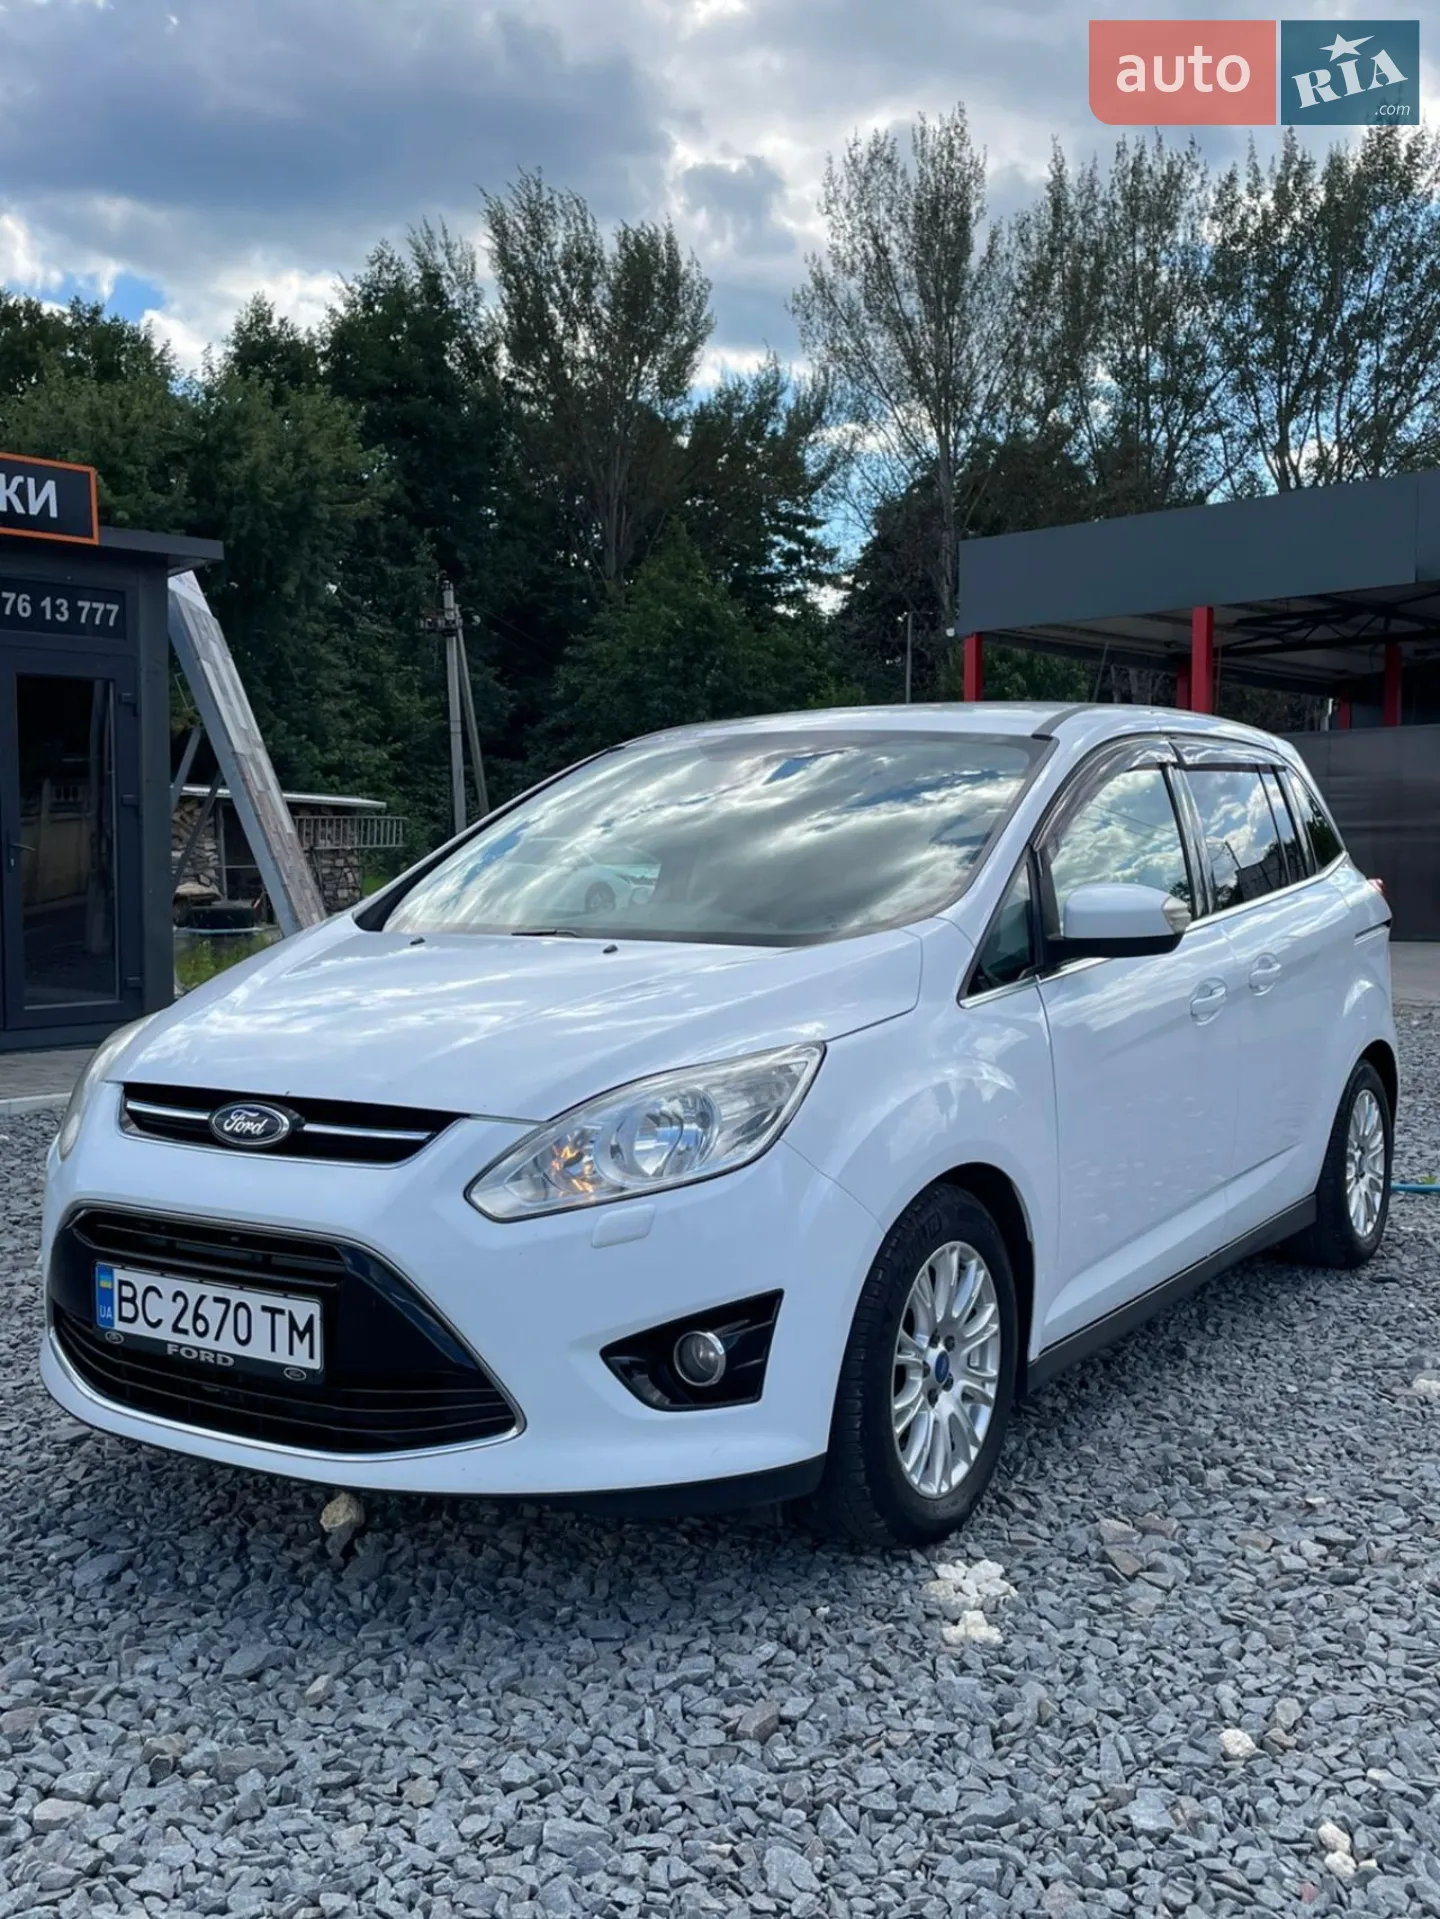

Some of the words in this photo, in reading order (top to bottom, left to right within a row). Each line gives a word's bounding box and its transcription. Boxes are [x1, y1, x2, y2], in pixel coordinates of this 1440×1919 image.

[0, 473, 58, 518] КИ
[1, 592, 32, 618] 76
[40, 597, 69, 622] 13
[77, 601, 119, 627] 777
[223, 1109, 268, 1135] Ford
[99, 1304, 113, 1319] UA
[117, 1279, 164, 1329] BC
[171, 1290, 252, 1346] 2670
[260, 1305, 315, 1360] TM
[166, 1343, 235, 1367] FORD
